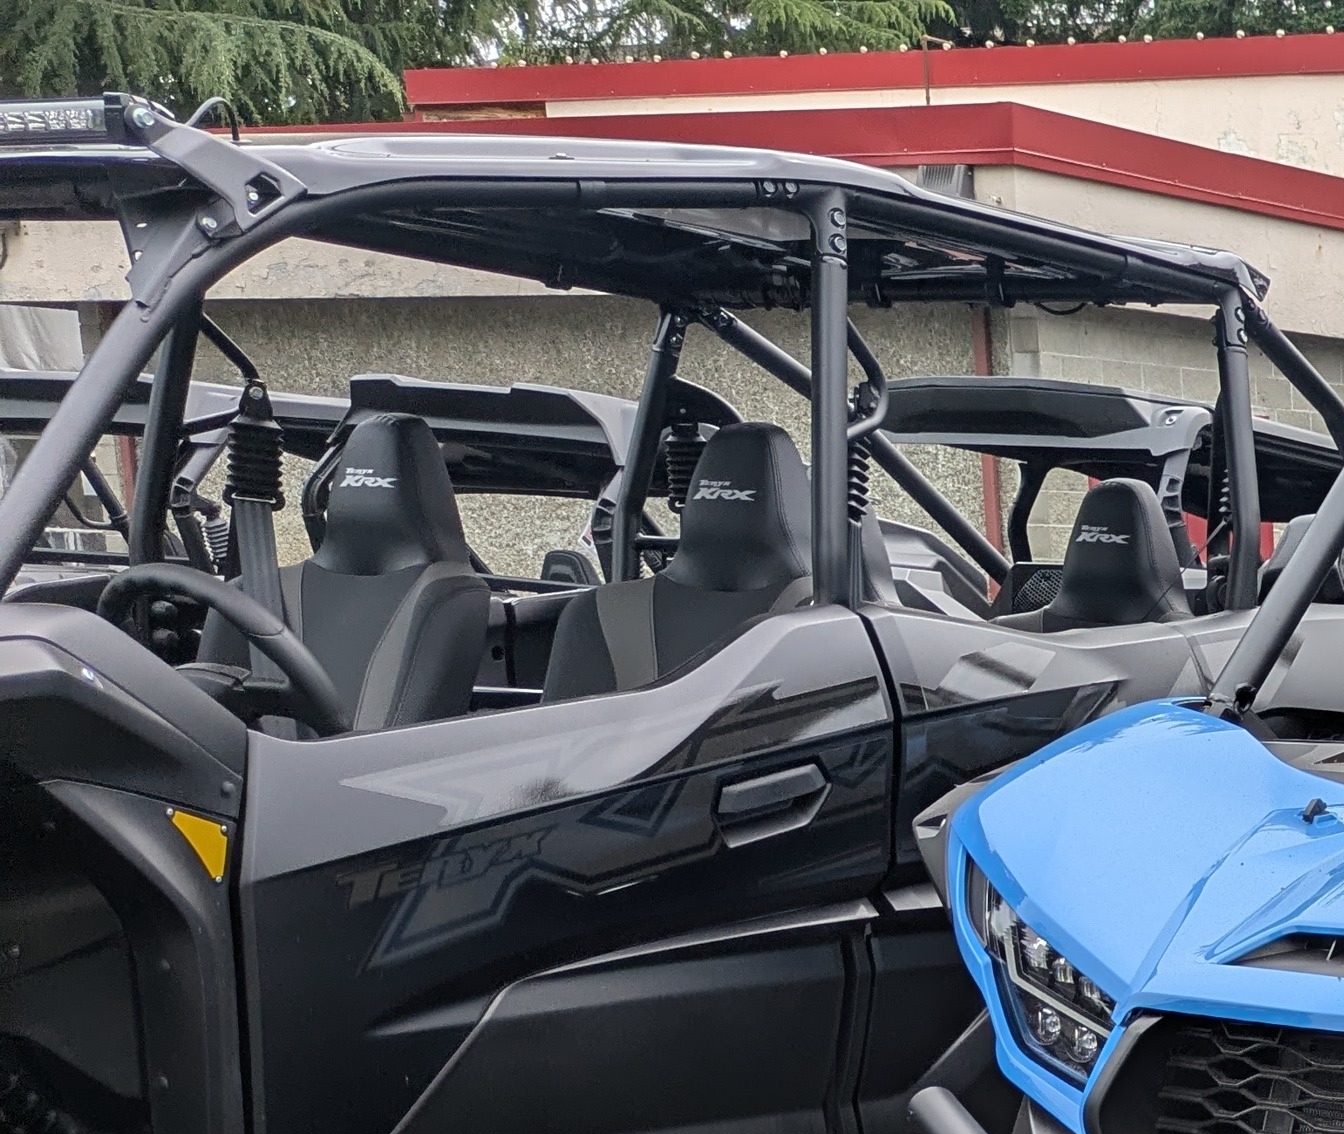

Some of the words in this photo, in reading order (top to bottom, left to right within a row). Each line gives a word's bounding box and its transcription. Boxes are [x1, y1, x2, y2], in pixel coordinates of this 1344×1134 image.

[340, 475, 398, 488] KRX
[693, 487, 757, 501] KRX
[1075, 531, 1131, 544] KRX
